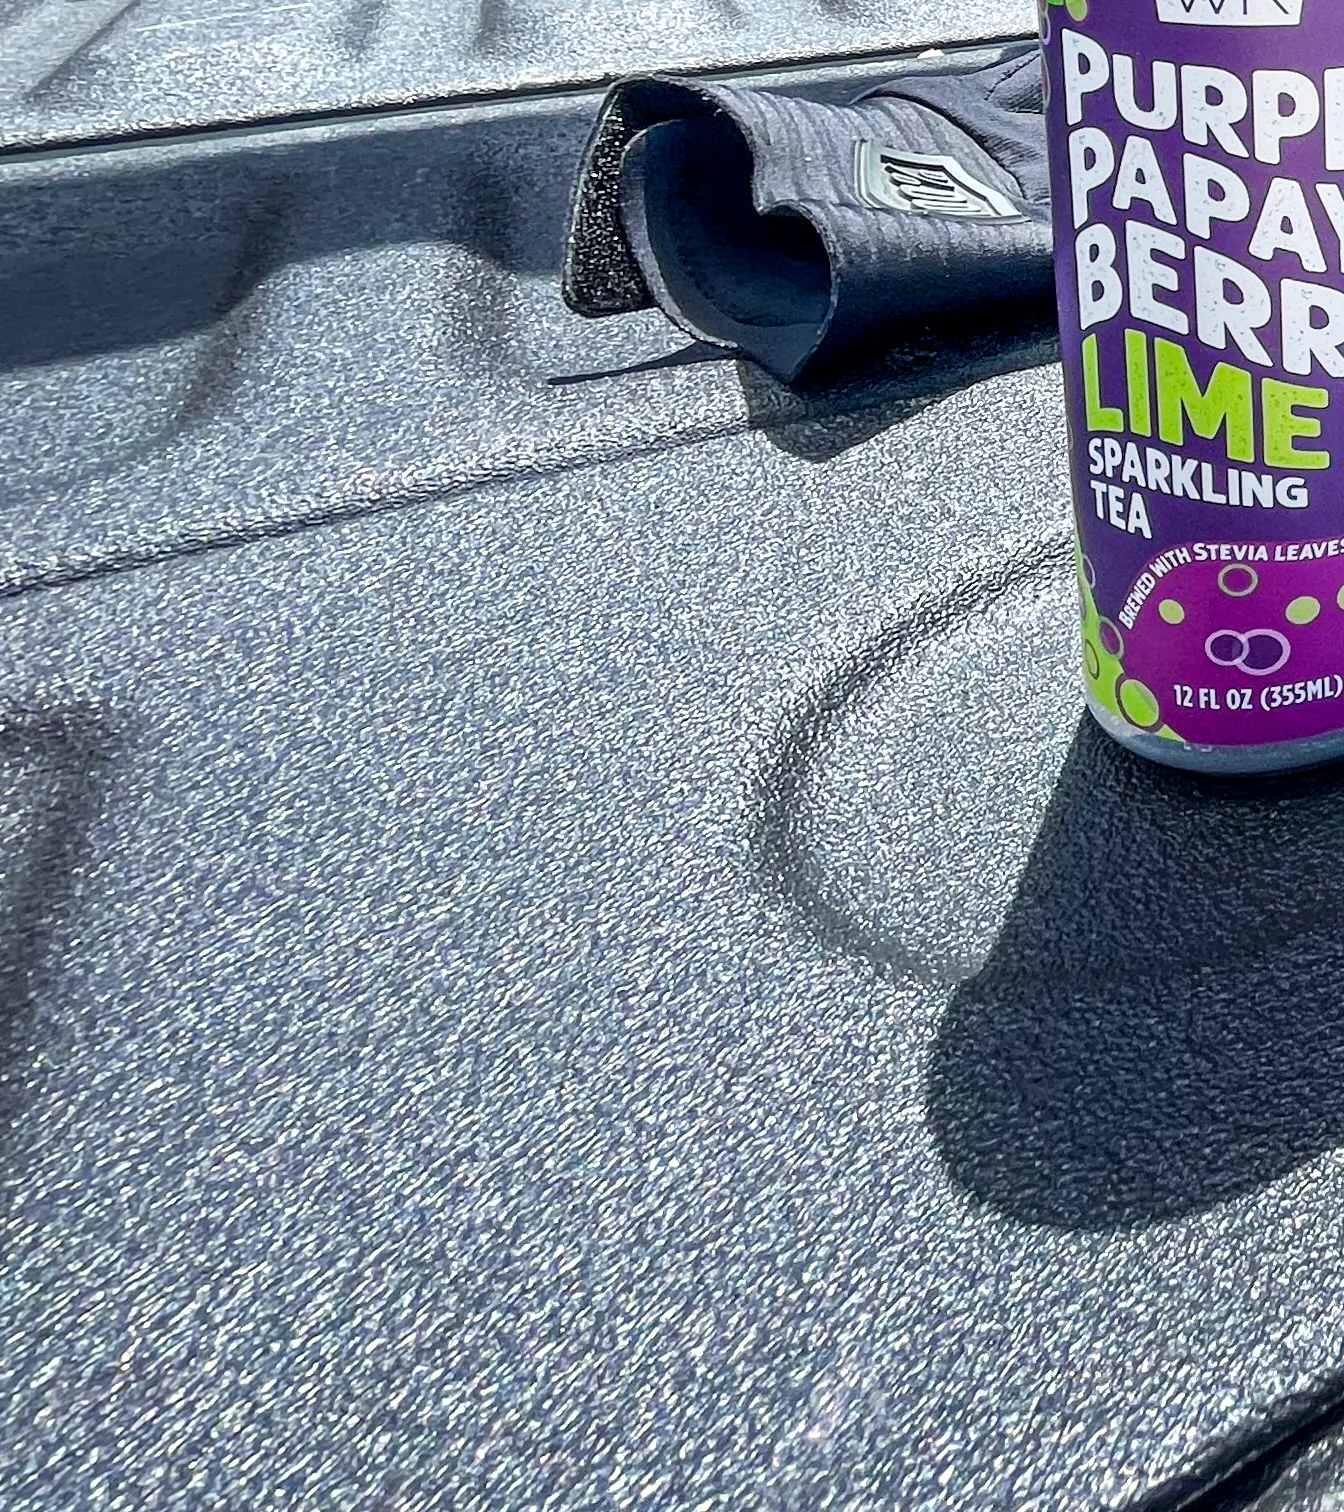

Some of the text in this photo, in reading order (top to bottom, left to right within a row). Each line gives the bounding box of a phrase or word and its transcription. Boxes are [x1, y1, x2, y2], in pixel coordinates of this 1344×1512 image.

[1082, 328, 1330, 469] LIME
[1088, 438, 1309, 508] SPARKLING
[1090, 480, 1152, 539] TEA
[1118, 573, 1156, 630] BREWED
[1149, 547, 1191, 578] WITH
[1192, 543, 1269, 562] STEVIA
[1174, 675, 1343, 711] 12 FL OZ (355ML)
